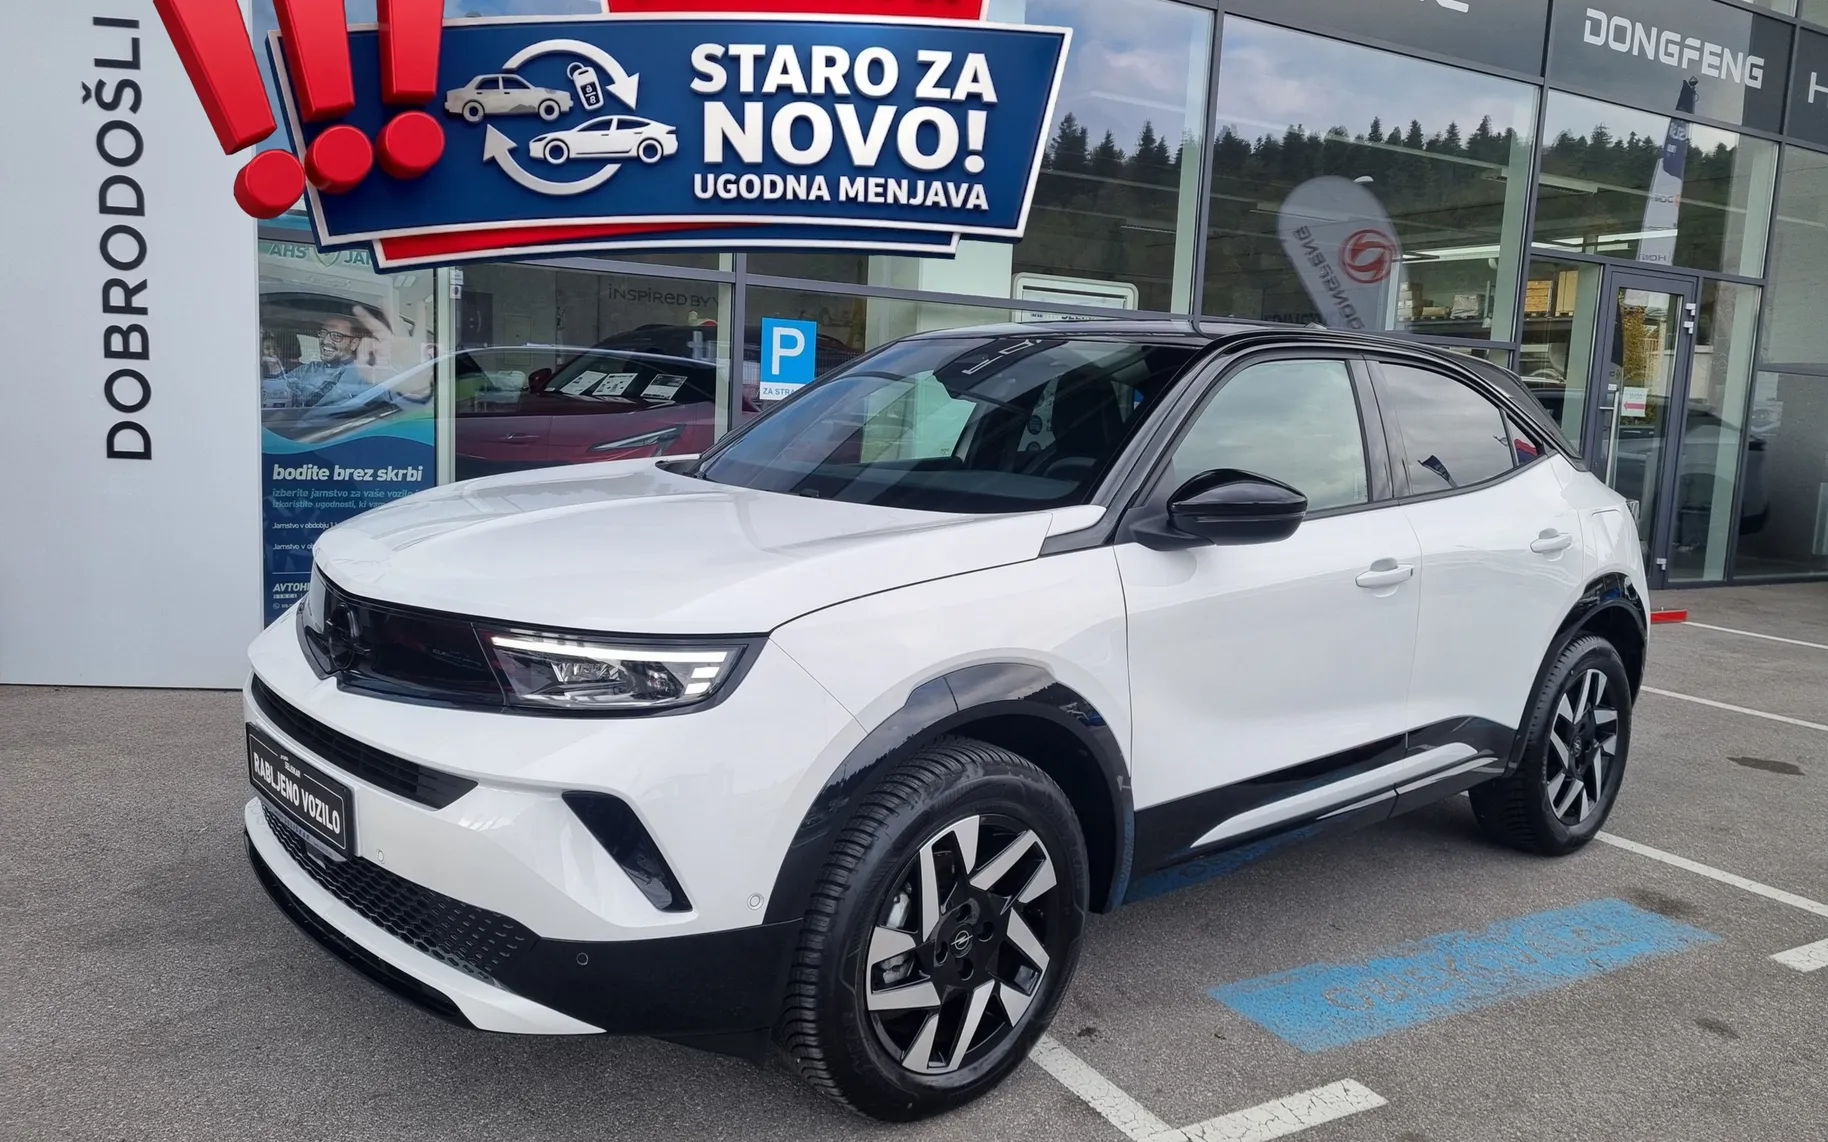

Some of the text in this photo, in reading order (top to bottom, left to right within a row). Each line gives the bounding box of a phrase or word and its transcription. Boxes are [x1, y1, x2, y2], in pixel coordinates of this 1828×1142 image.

[1584, 8, 1764, 89] DONGFENG
[81, 17, 152, 460] DOBRODOŠLI
[771, 326, 805, 375] P
[272, 464, 423, 482] bodite brez skrbi
[272, 488, 309, 498] izberite
[310, 489, 349, 499] jamstvo
[363, 488, 385, 498] vaše
[272, 500, 313, 509] izkoristite
[272, 522, 300, 530] Jamstvo
[273, 543, 300, 551] Jamstvo
[253, 751, 300, 807] RABLJENO
[300, 787, 341, 834] VOZILO
